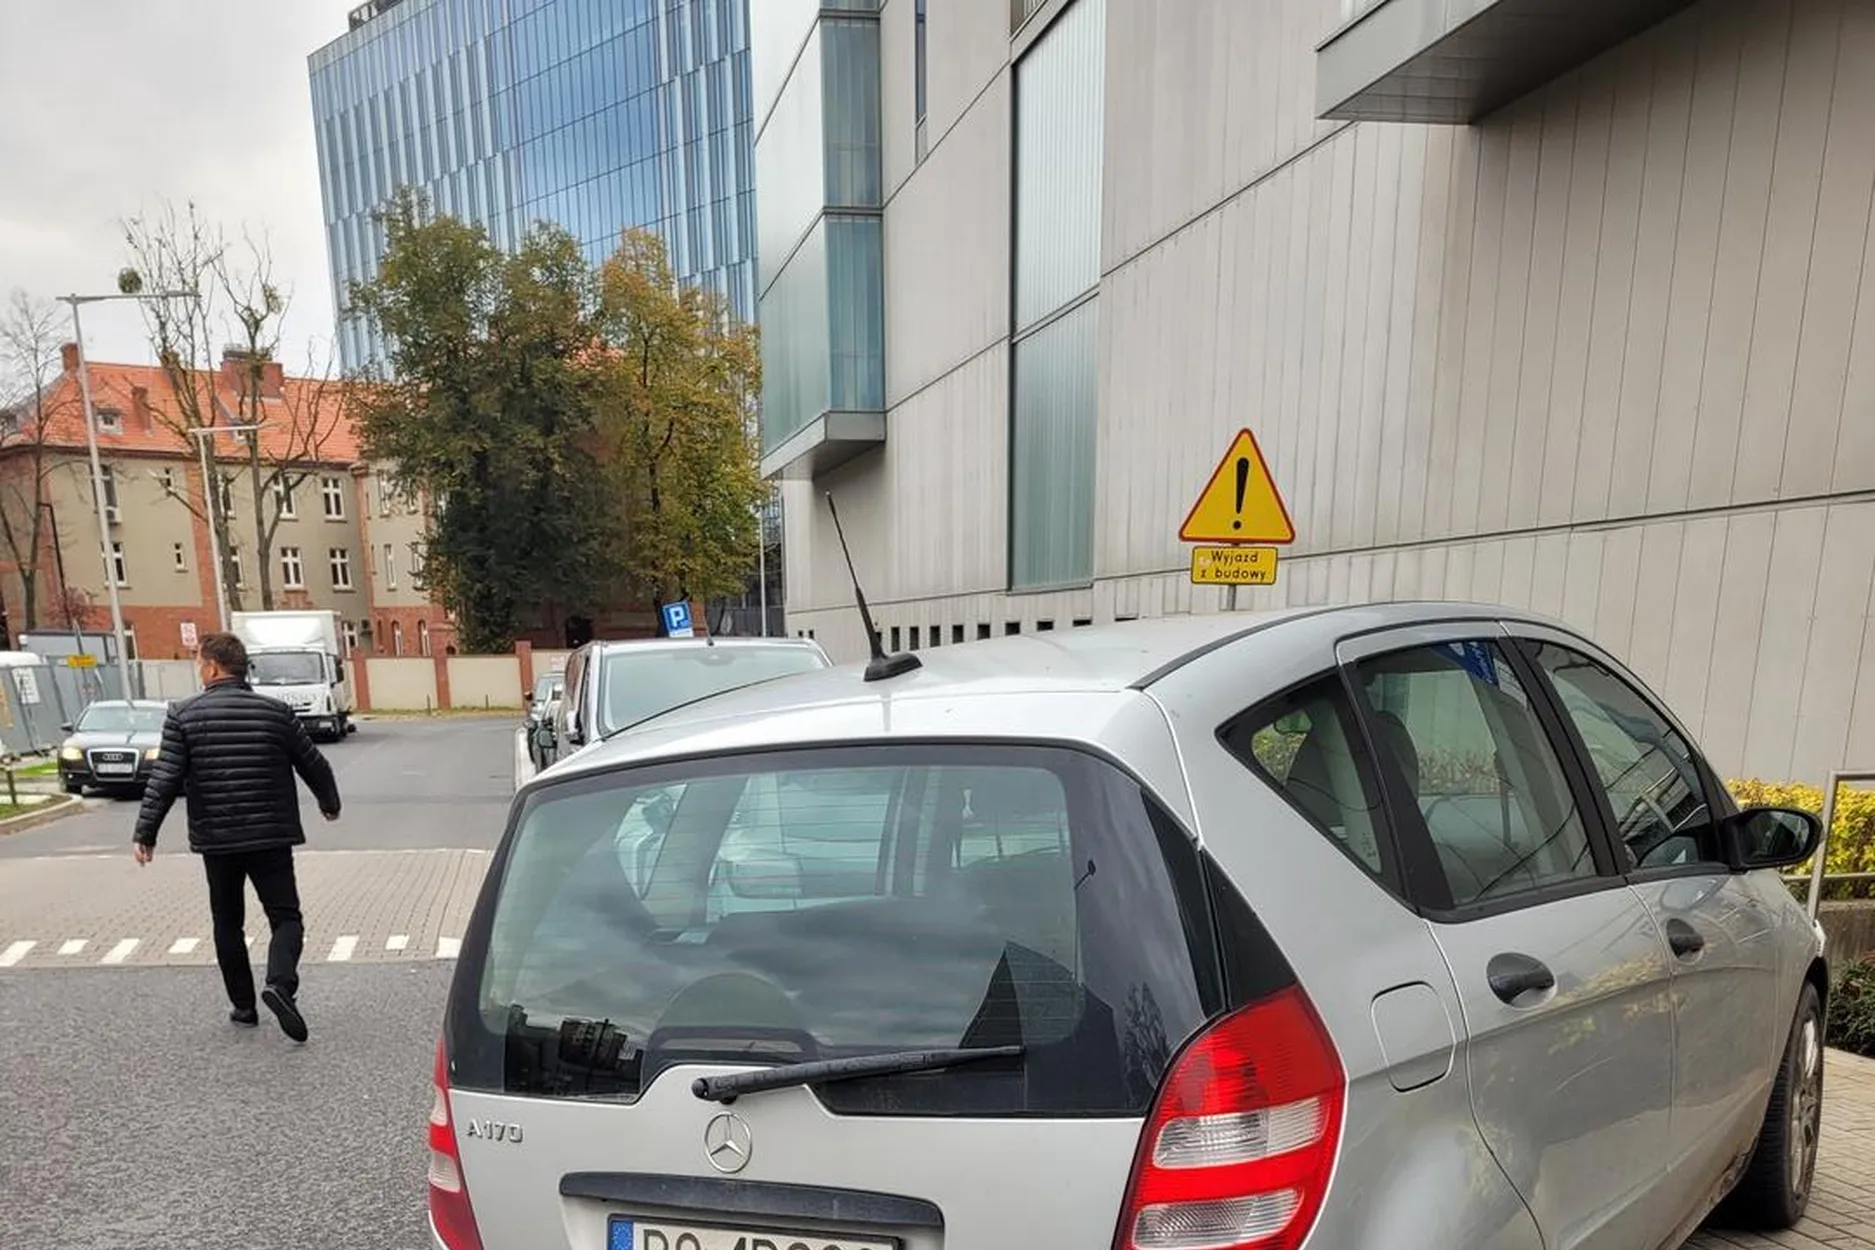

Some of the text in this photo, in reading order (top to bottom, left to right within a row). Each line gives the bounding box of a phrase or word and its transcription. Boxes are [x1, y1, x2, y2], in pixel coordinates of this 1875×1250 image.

[1211, 551, 1258, 565] Wyjazd
[1200, 568, 1266, 580] z budowy
[670, 606, 685, 627] P
[467, 1119, 524, 1144] A170
